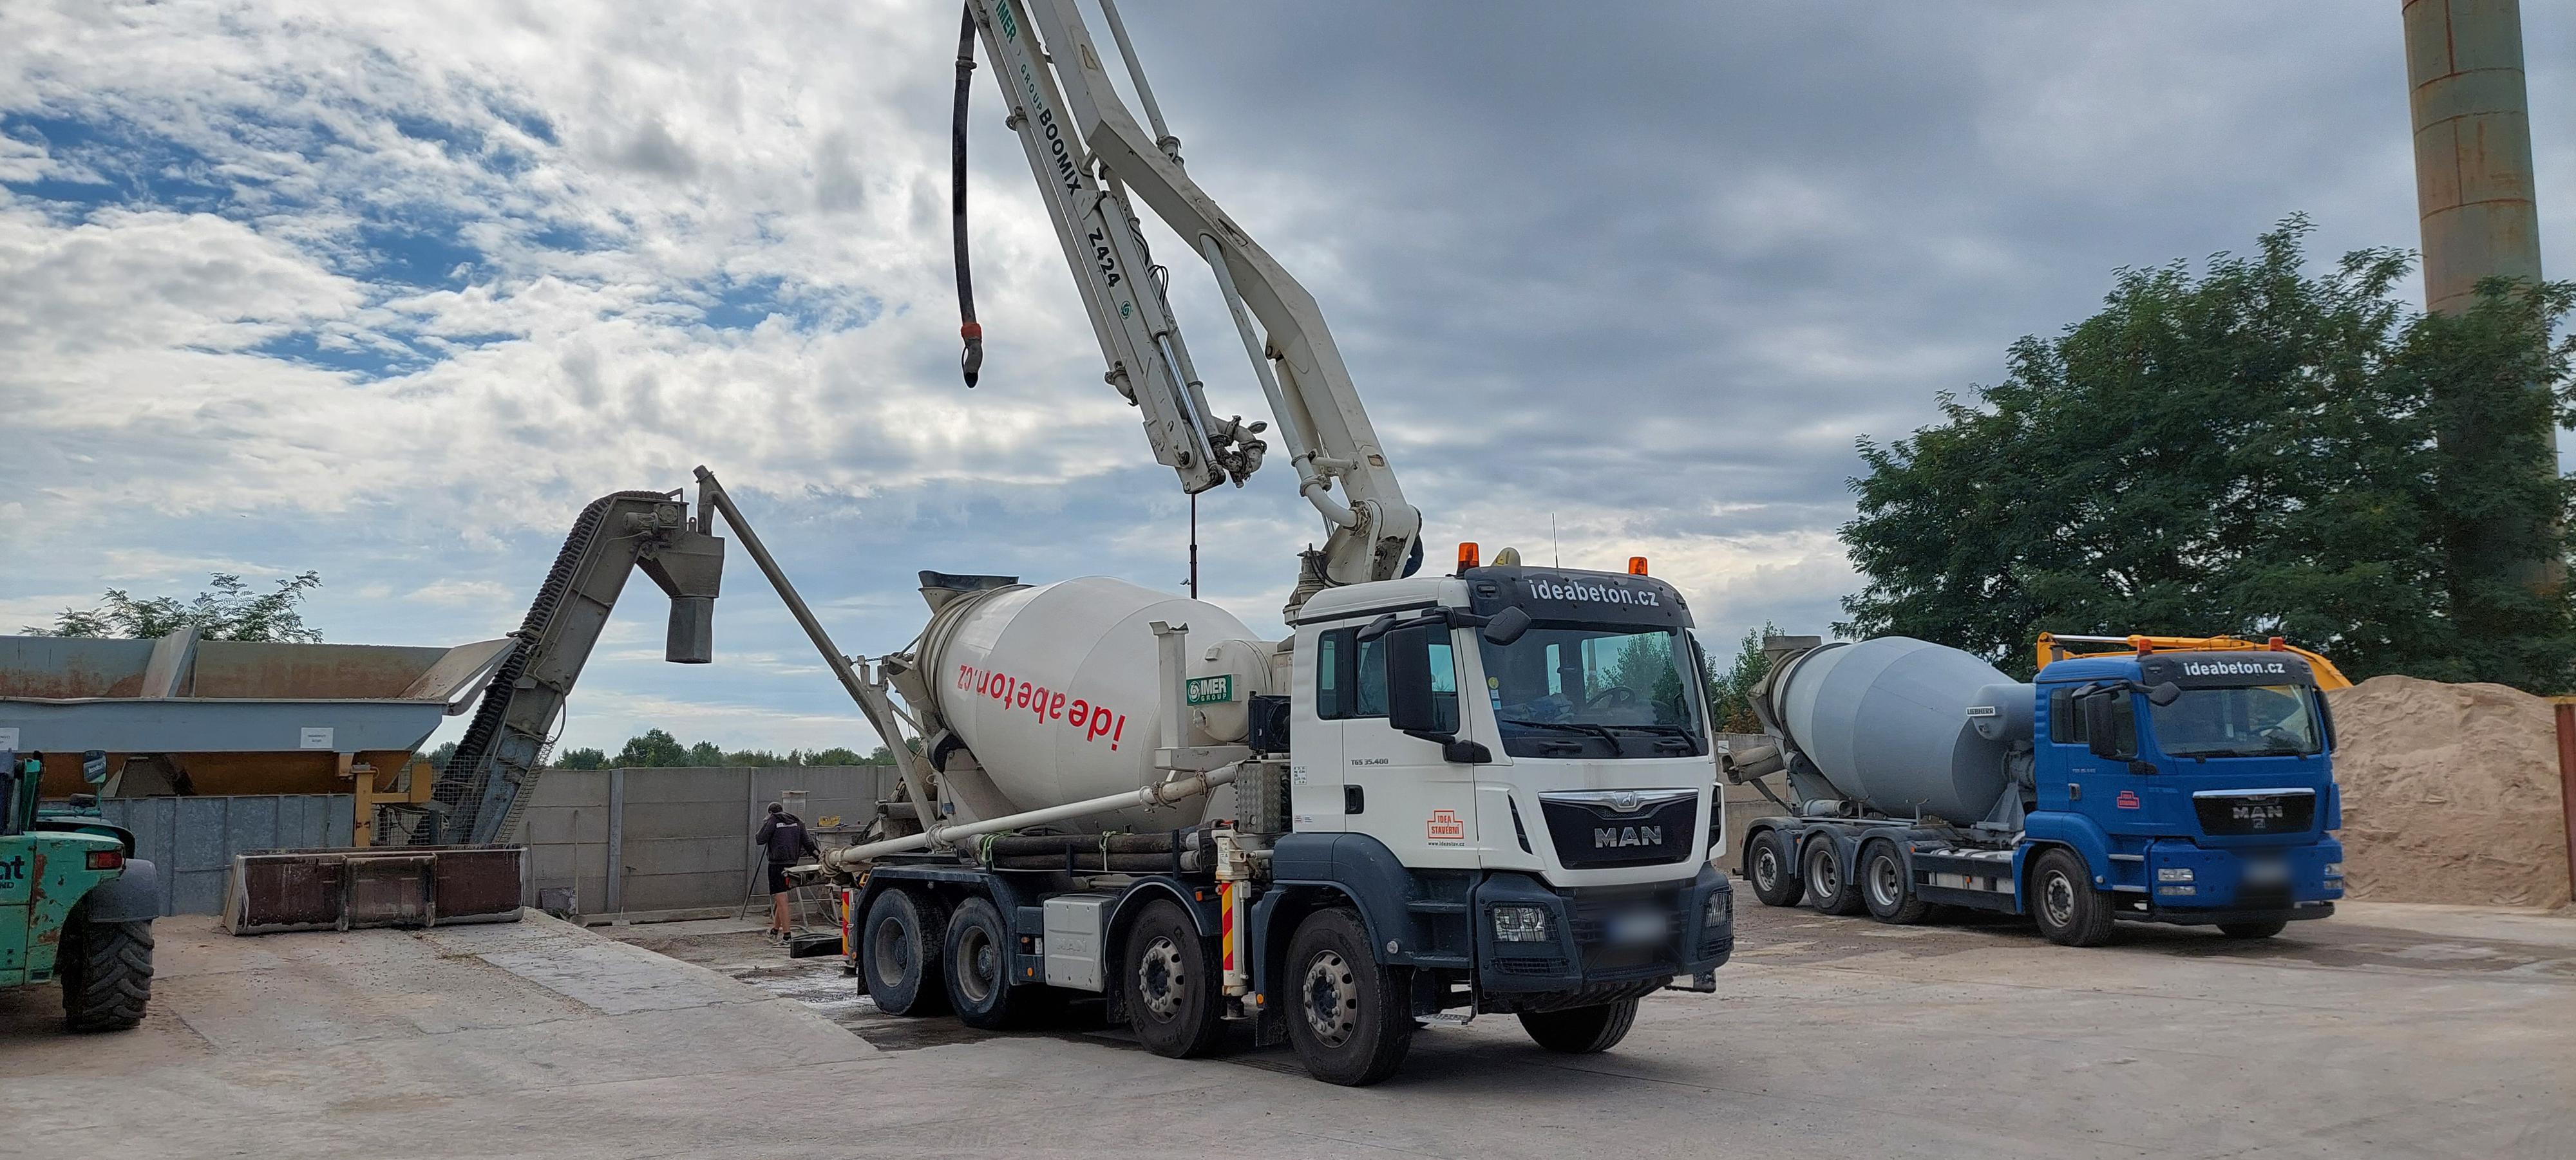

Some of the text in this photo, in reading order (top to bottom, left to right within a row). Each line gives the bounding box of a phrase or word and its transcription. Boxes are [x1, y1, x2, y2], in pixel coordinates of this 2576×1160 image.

[996, 0, 1043, 111] IMER GROUP
[1039, 108, 1082, 197] BOOMIX
[1528, 579, 1660, 606] ideabeton.cz
[2183, 661, 2286, 675] ideabeton.cz
[1201, 678, 1227, 695] IMER
[957, 664, 1126, 752] ideabeton.cz
[1437, 815, 1452, 823] IDEA
[2232, 806, 2283, 818] MAN
[1595, 825, 1662, 848] MAN
